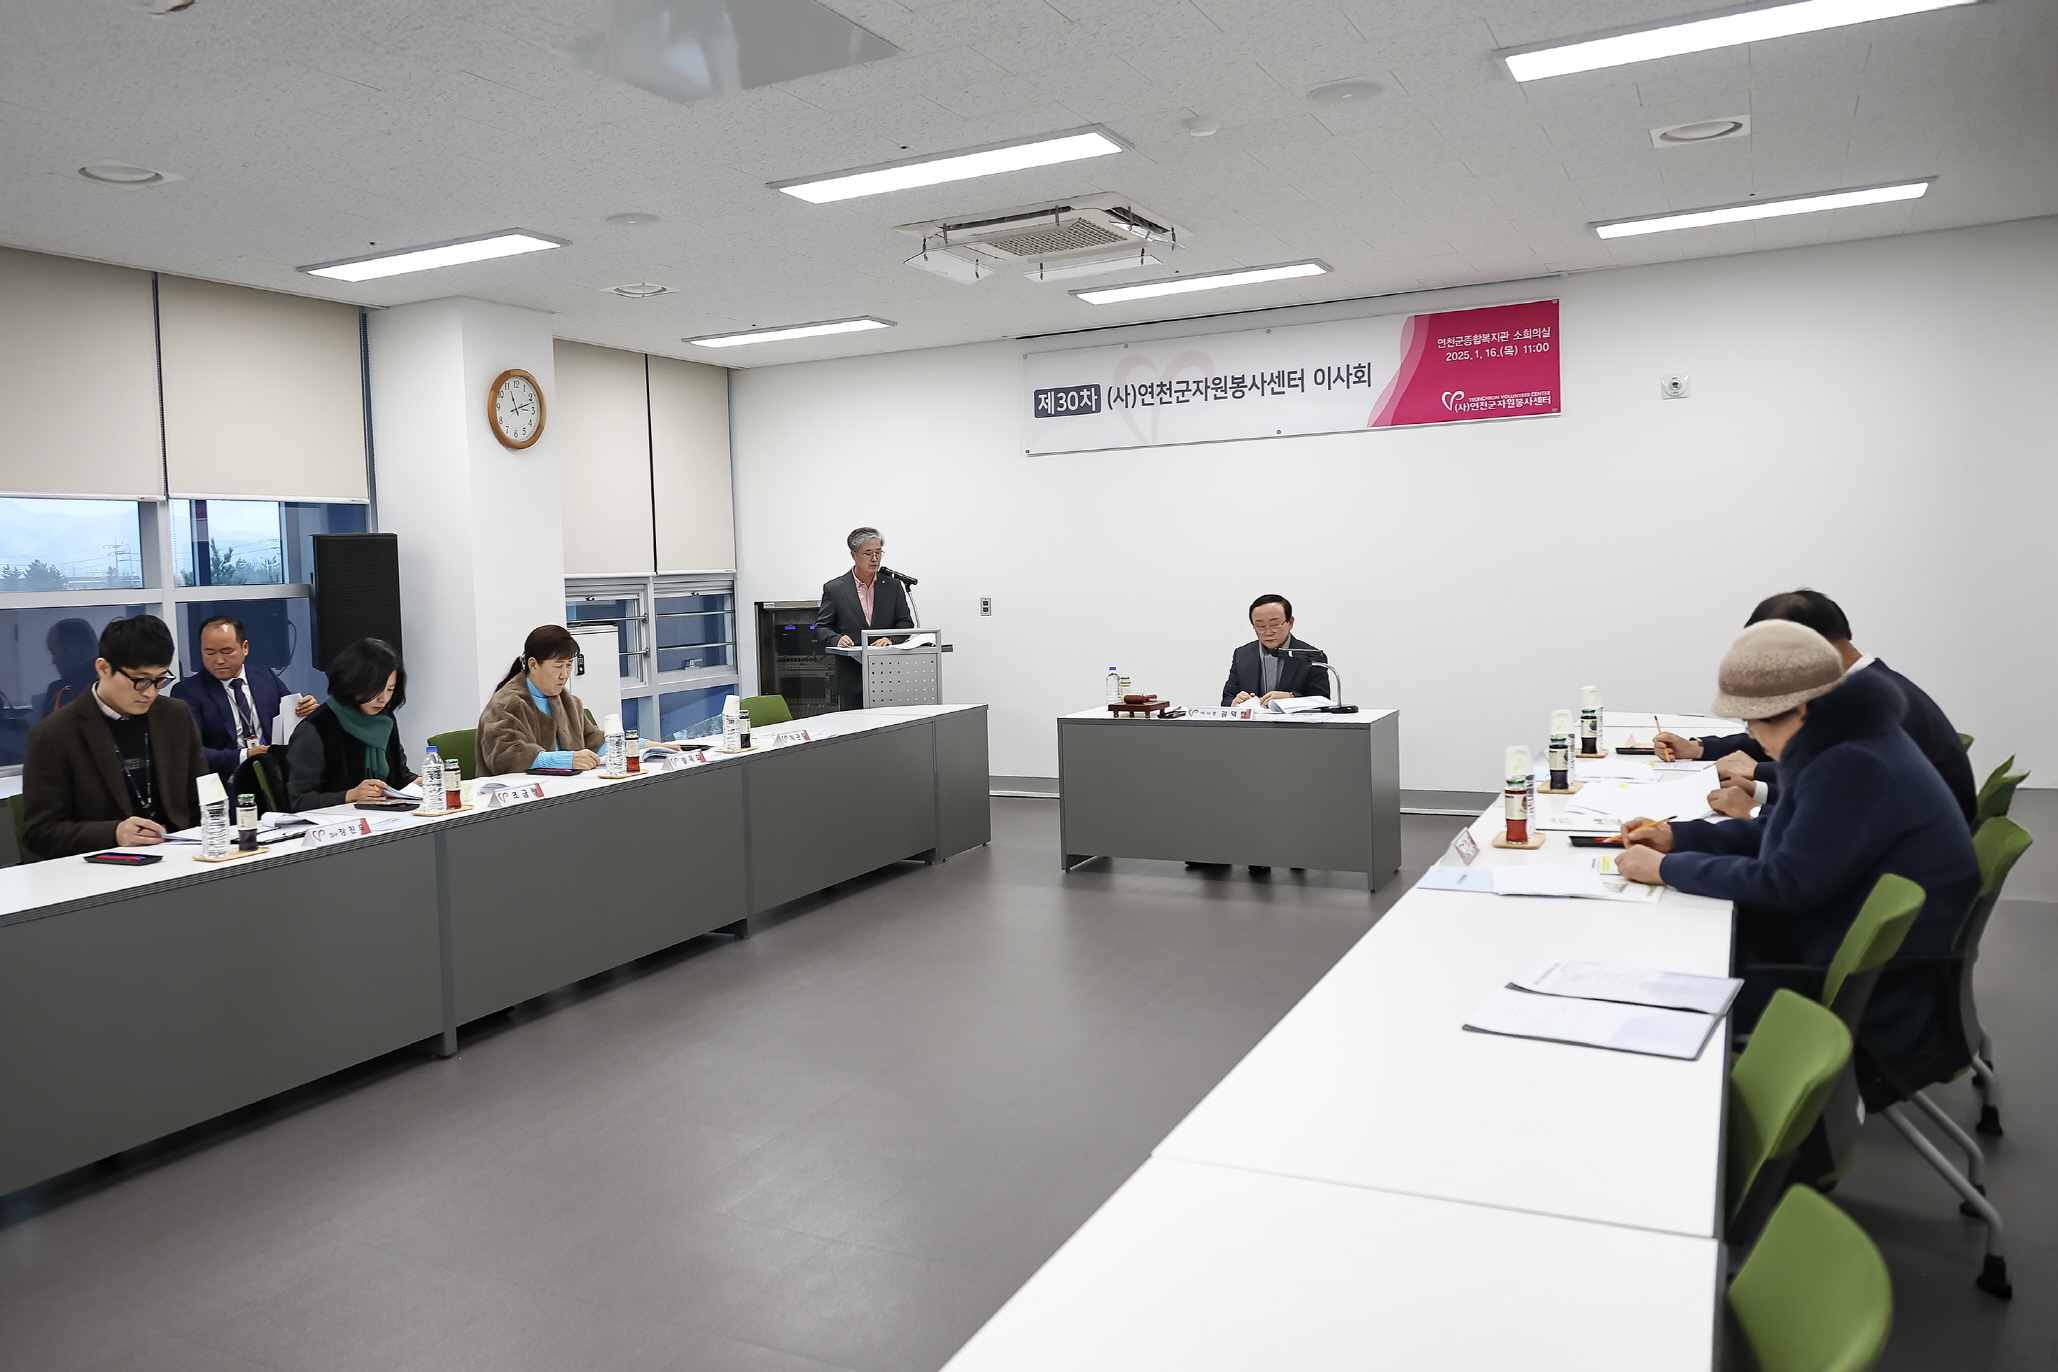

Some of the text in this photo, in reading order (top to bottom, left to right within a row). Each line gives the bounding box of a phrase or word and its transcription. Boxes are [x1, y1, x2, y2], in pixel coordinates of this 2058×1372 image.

[1437, 326, 1551, 349] 연천군종합복지관 소회의실
[1523, 342, 1550, 354] 11:00
[504, 382, 510, 390] 11
[513, 380, 520, 388] 12
[1038, 362, 1372, 415] 제30차 (사)연천군자원봉사센터 이사회
[528, 392, 532, 402] 2
[496, 402, 500, 411] 9
[1454, 395, 1552, 413] (사)연천군자원봉사센터
[531, 406, 536, 415] 3
[499, 416, 503, 424] 8
[528, 419, 532, 427] 4
[505, 425, 509, 434] 7
[514, 430, 518, 438] 6
[522, 427, 526, 436] 5
